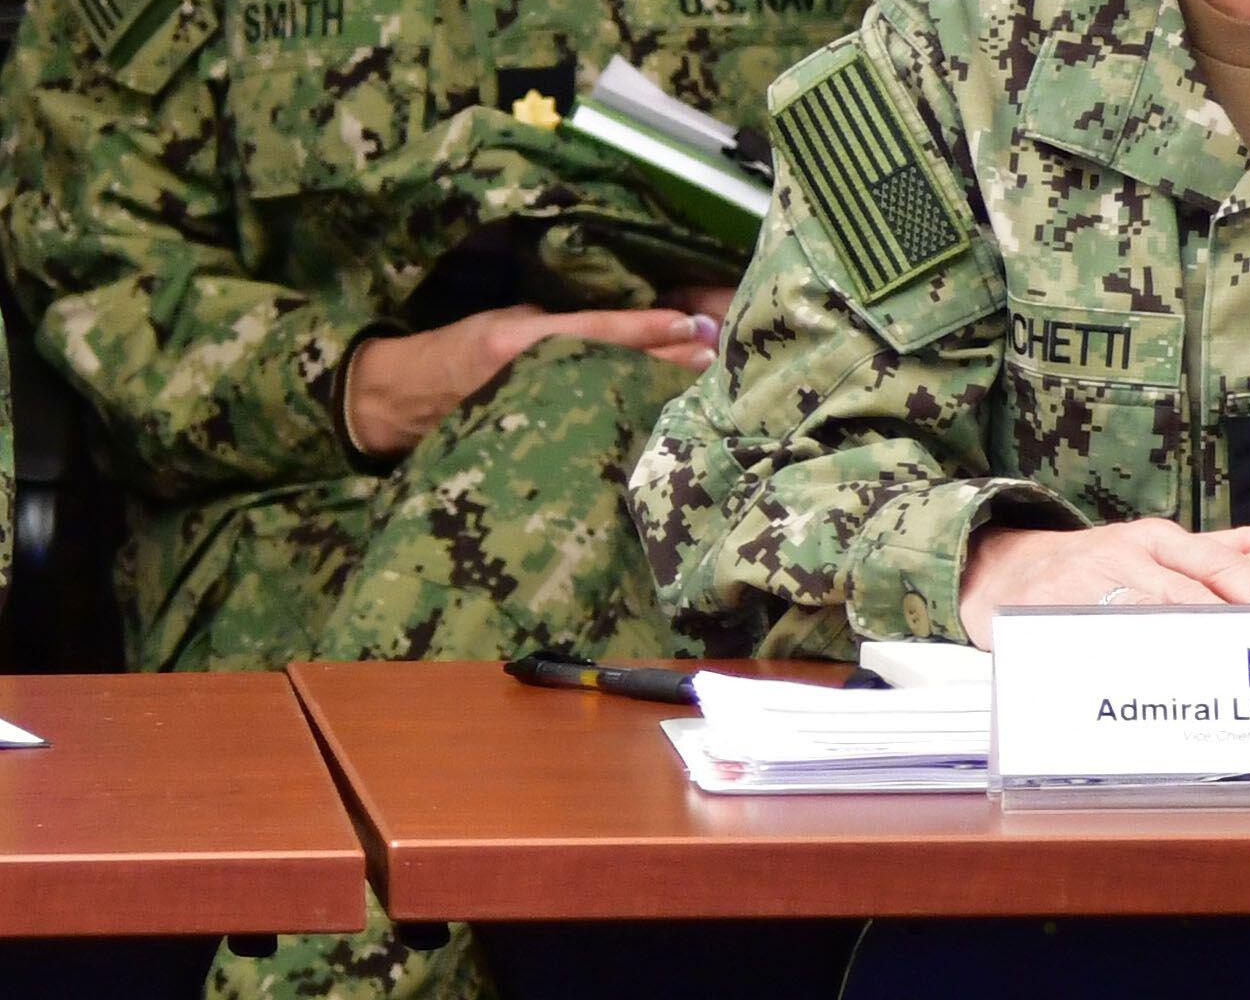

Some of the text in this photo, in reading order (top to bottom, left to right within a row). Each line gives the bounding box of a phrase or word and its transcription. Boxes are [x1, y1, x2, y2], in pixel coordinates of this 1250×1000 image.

[1008, 308, 1132, 370] CHETTI
[1096, 698, 1219, 721] Admiral
[1183, 729, 1211, 743] Vice
